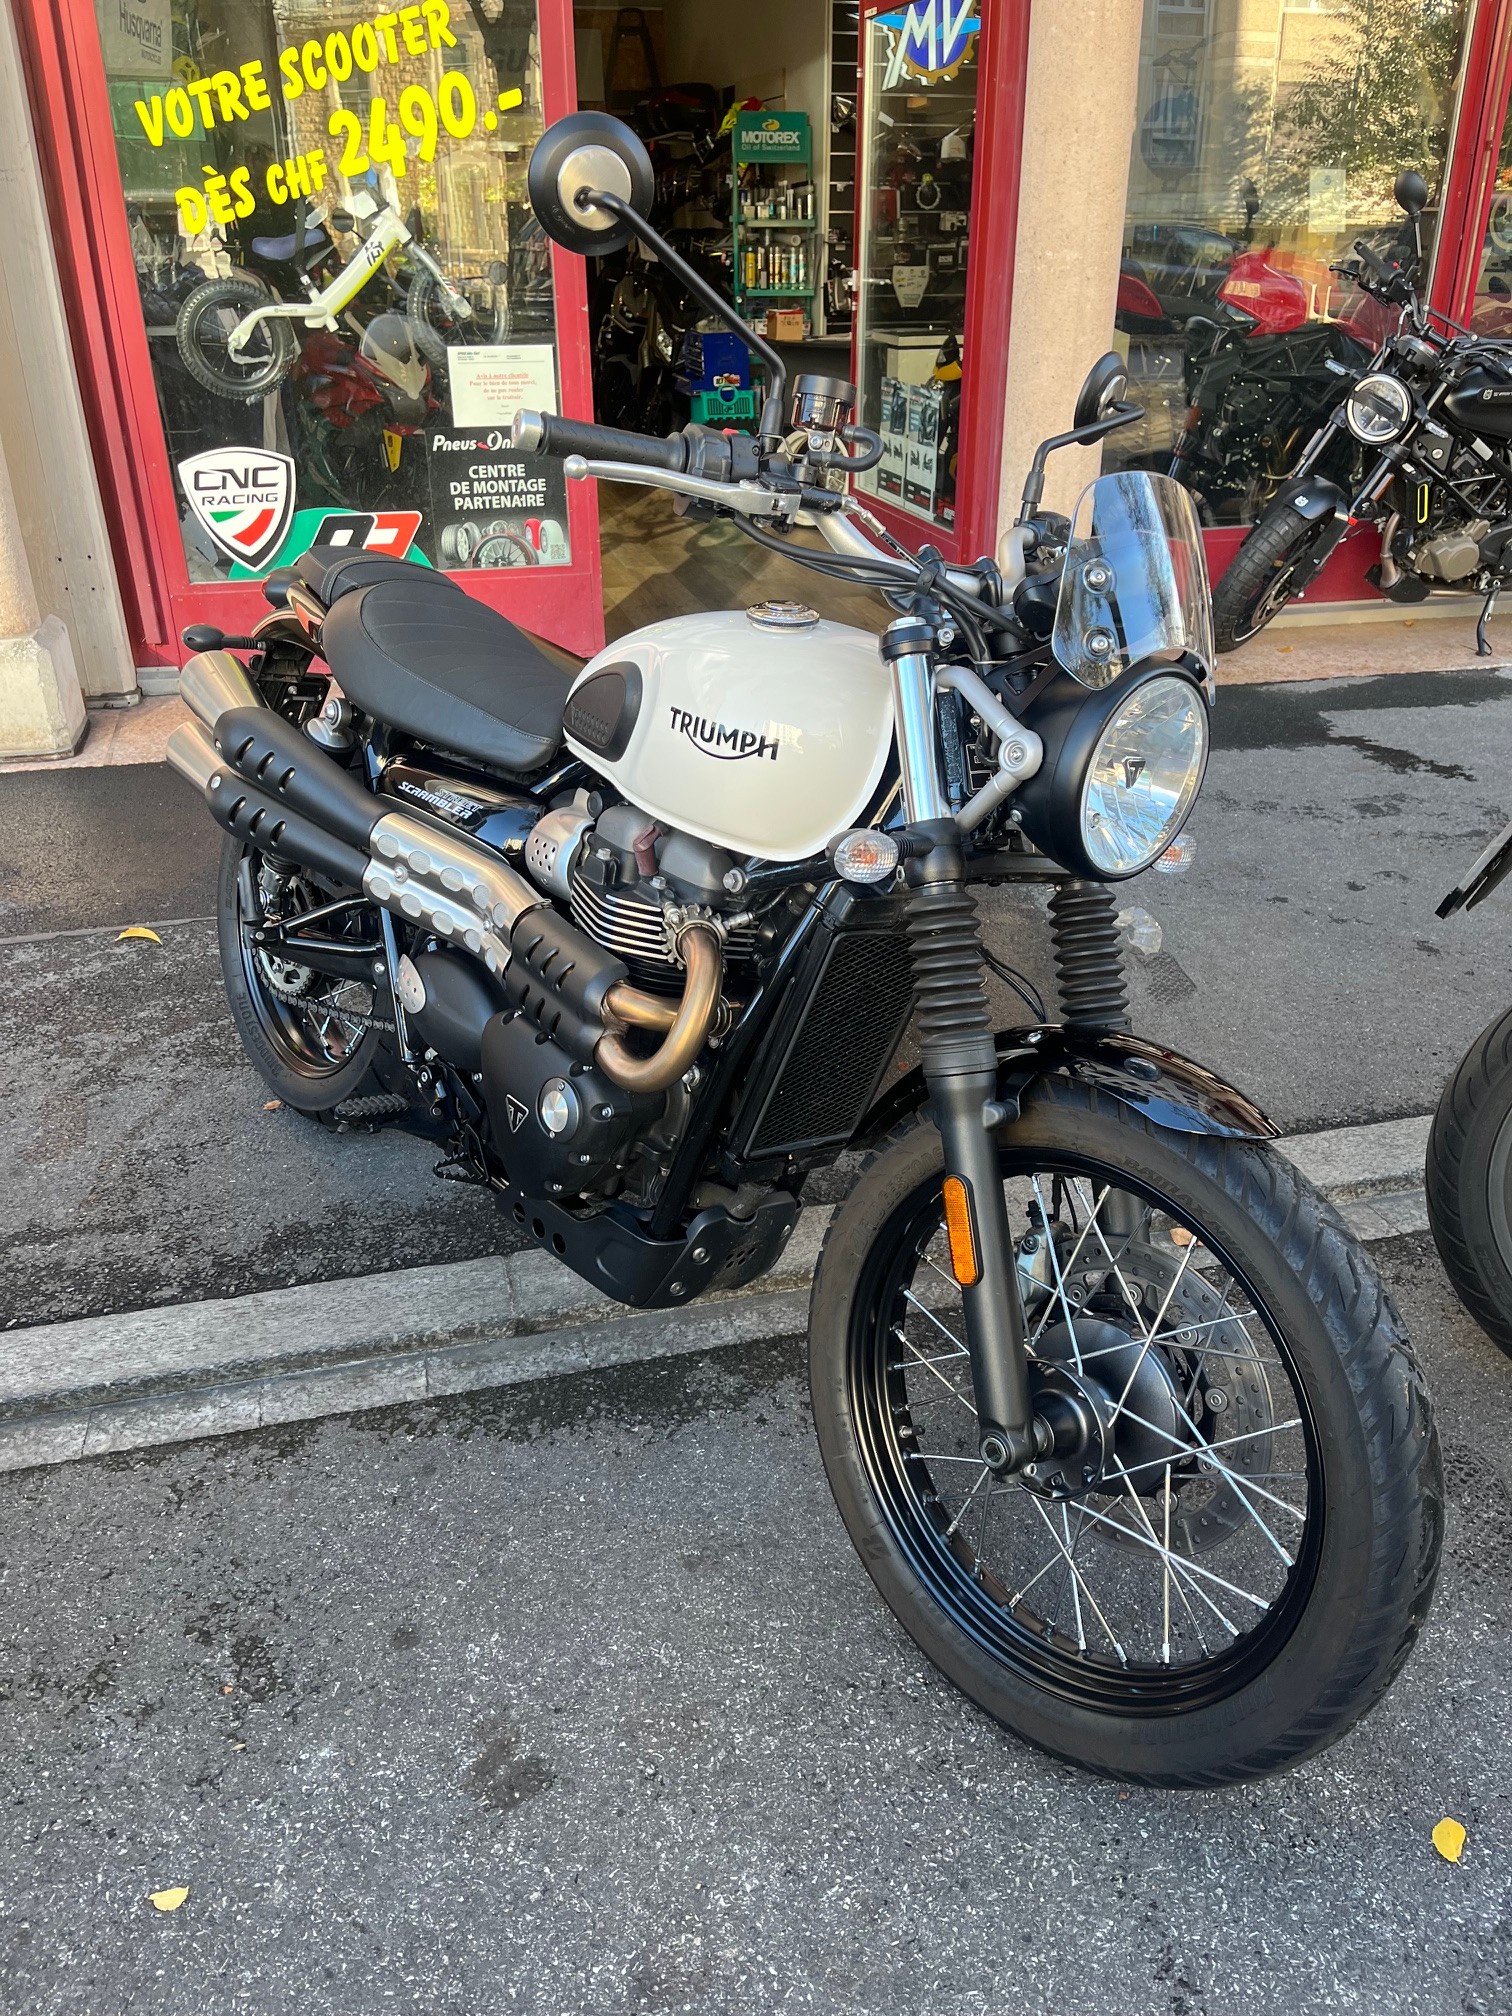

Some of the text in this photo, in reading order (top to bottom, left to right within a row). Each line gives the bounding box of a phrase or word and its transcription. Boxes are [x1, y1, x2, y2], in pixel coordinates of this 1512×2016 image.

[119, 0, 163, 47] Husqvarna
[134, 0, 457, 147] VOTRE SCOOTER
[741, 130, 800, 144] MOTOREX
[175, 70, 523, 235] DÈS CHF 2490.-
[432, 434, 477, 452] Pneus
[194, 466, 280, 491] CNC
[468, 463, 527, 479] CENTRE
[449, 478, 547, 496] DE MONTAGE
[202, 492, 279, 506] RACING
[454, 493, 546, 511] PARTENAIRE
[670, 706, 780, 761] TRIUMPH
[398, 781, 473, 819] SCRAMBLER
